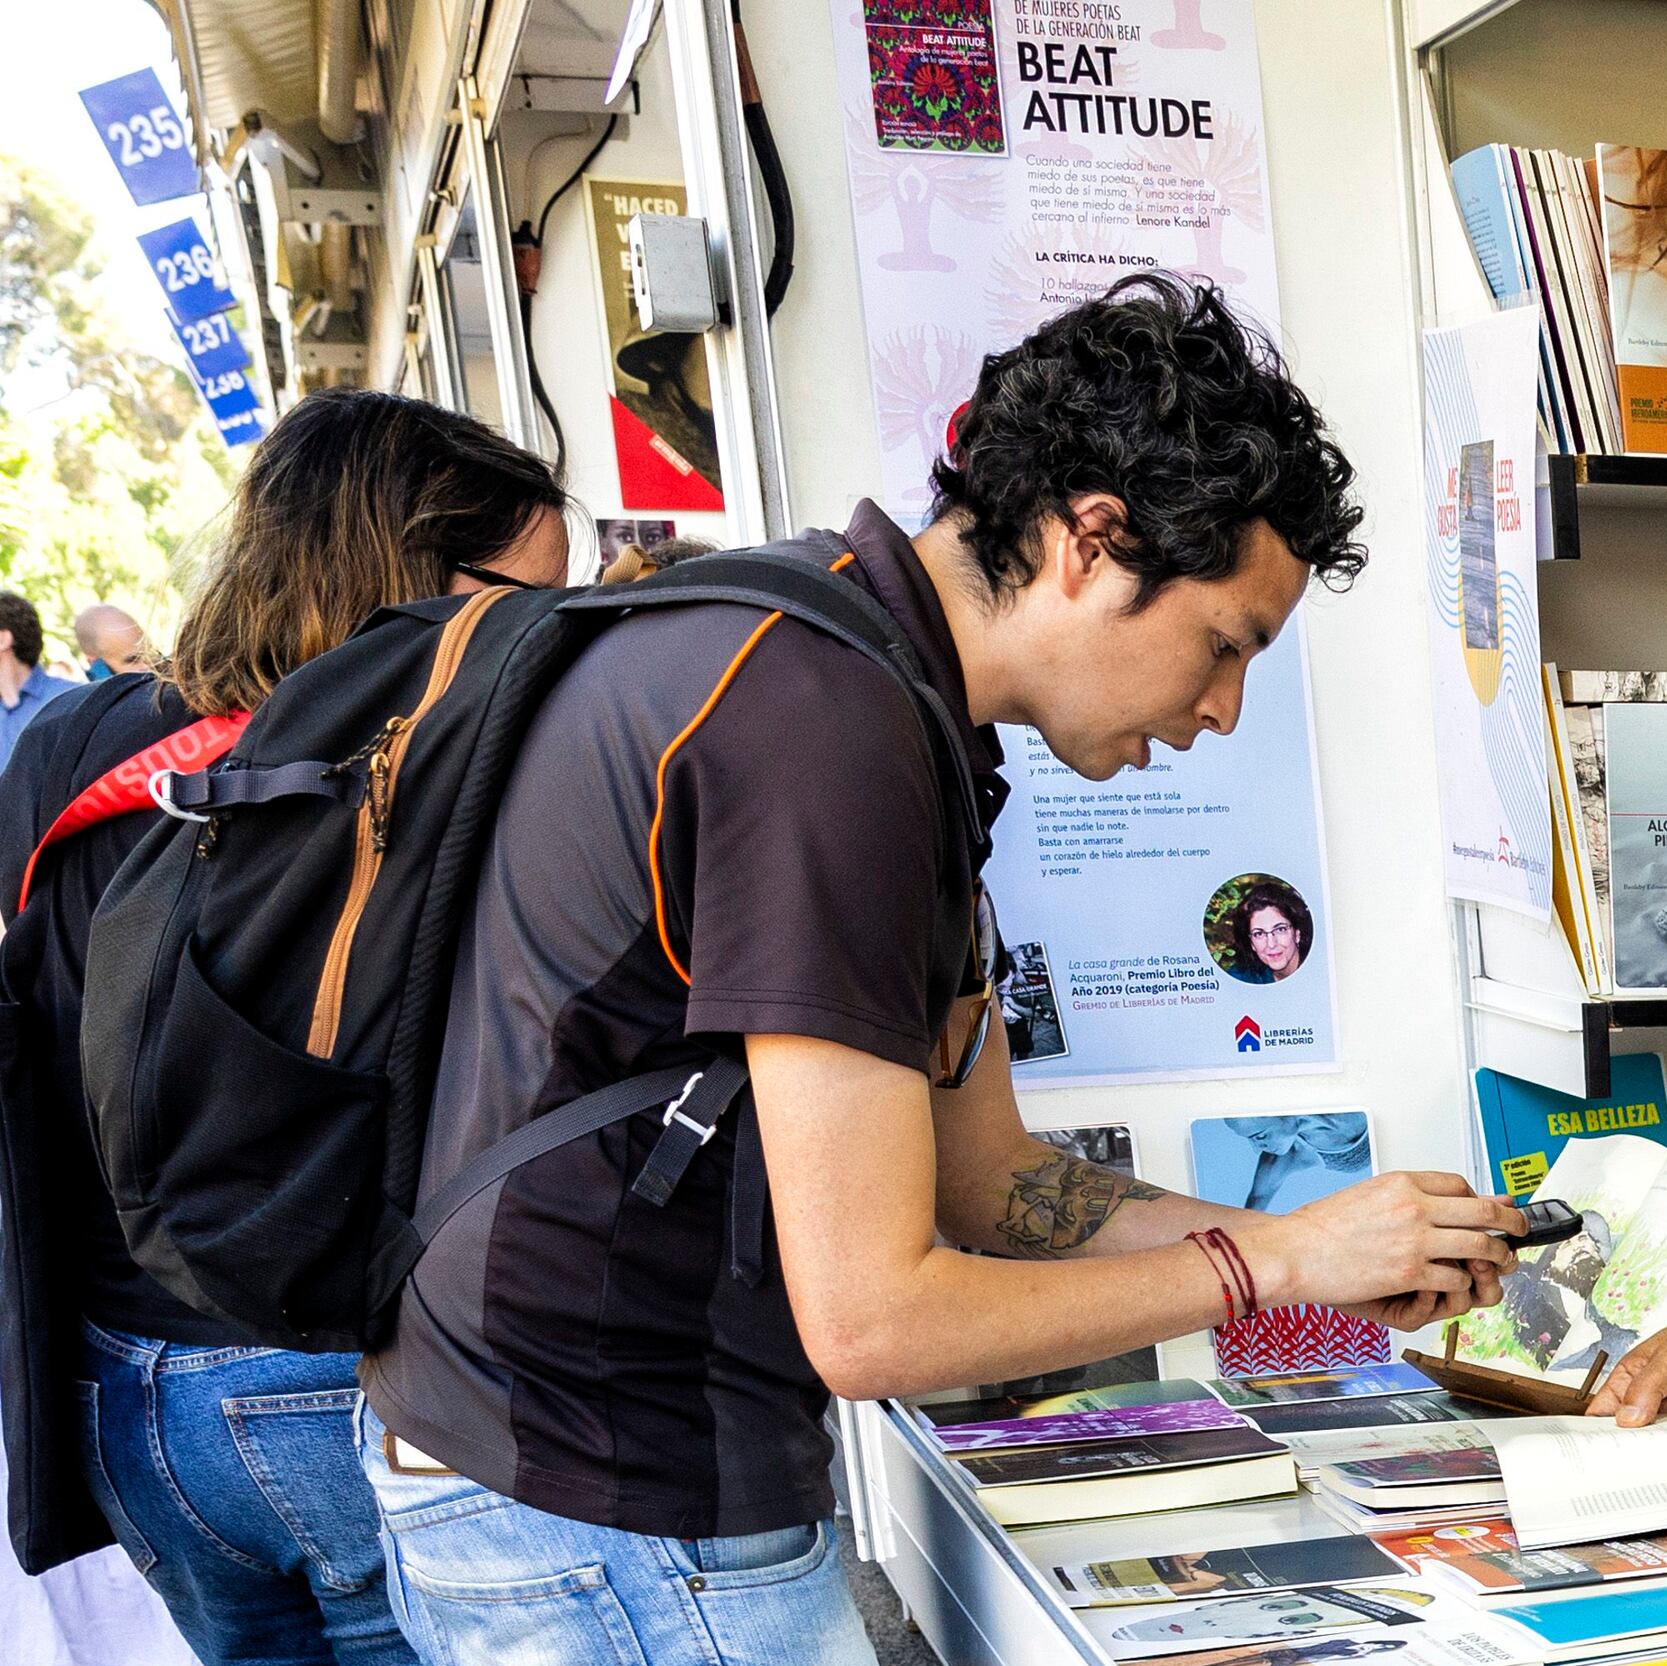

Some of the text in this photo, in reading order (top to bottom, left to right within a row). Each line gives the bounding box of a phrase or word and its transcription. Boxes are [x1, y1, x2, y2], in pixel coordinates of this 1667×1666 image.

[1015, 0, 1121, 20] DE MUJERES POETAS
[1017, 19, 1141, 41] DE LA GENERACIÓN BEAT
[1017, 42, 1117, 86] BEAT
[1023, 90, 1213, 139] ATTITUDE
[107, 105, 185, 168] 235
[156, 244, 213, 293] 236
[1036, 251, 1158, 266] LA CRÍTICA HA DICHO:
[182, 312, 231, 355] 237
[1033, 792, 1181, 806] Una mujer que siente que está sola
[1068, 955, 1200, 970] La casa grande de Rosana
[1070, 966, 1214, 984] Acquaroni, Premio Libro del
[1072, 979, 1220, 997] Año 2019 (categoría Poesía)
[1264, 1027, 1313, 1038] LIBRERÍAS
[1279, 1037, 1313, 1046] MADRID
[1547, 1102, 1661, 1137] ESA BELLEZA
